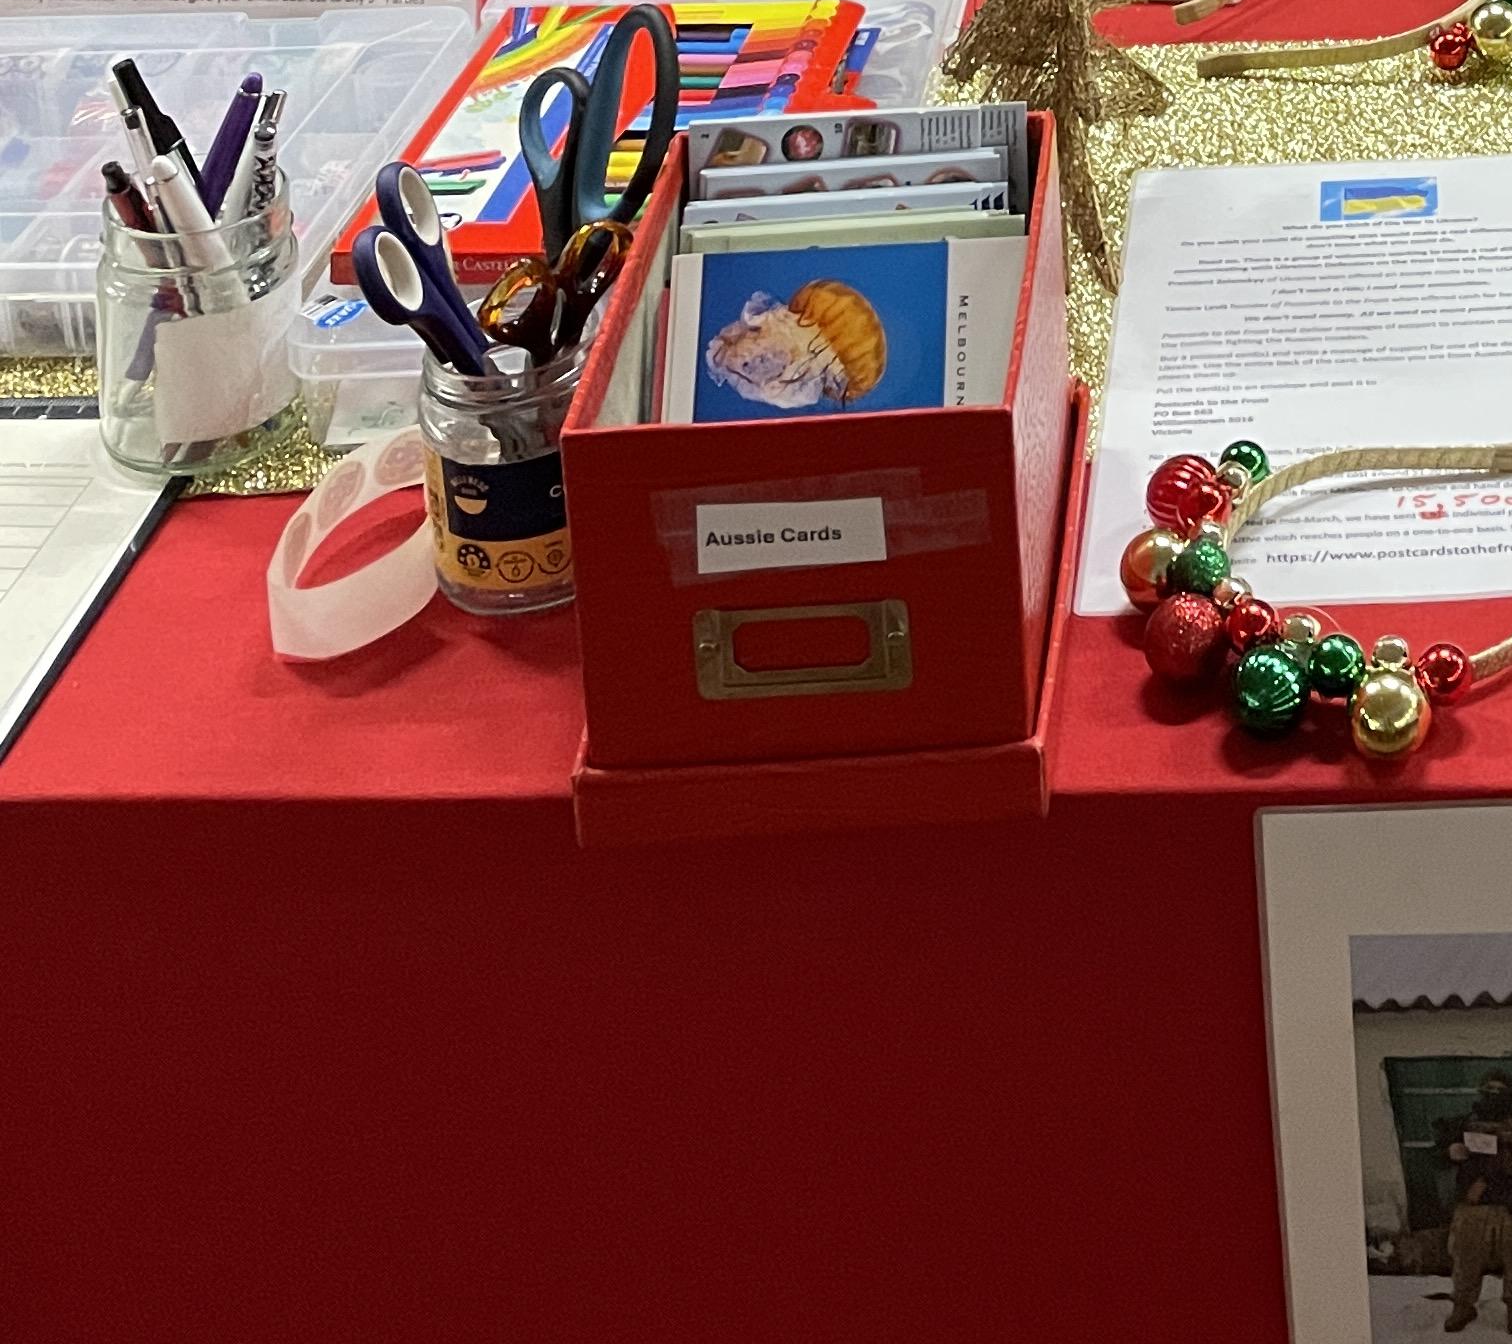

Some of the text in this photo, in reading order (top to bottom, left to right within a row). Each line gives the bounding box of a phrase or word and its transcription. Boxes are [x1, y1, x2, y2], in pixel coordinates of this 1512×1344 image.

[956, 295, 969, 406] MELBOURN
[705, 524, 842, 548] Aussie Cards
